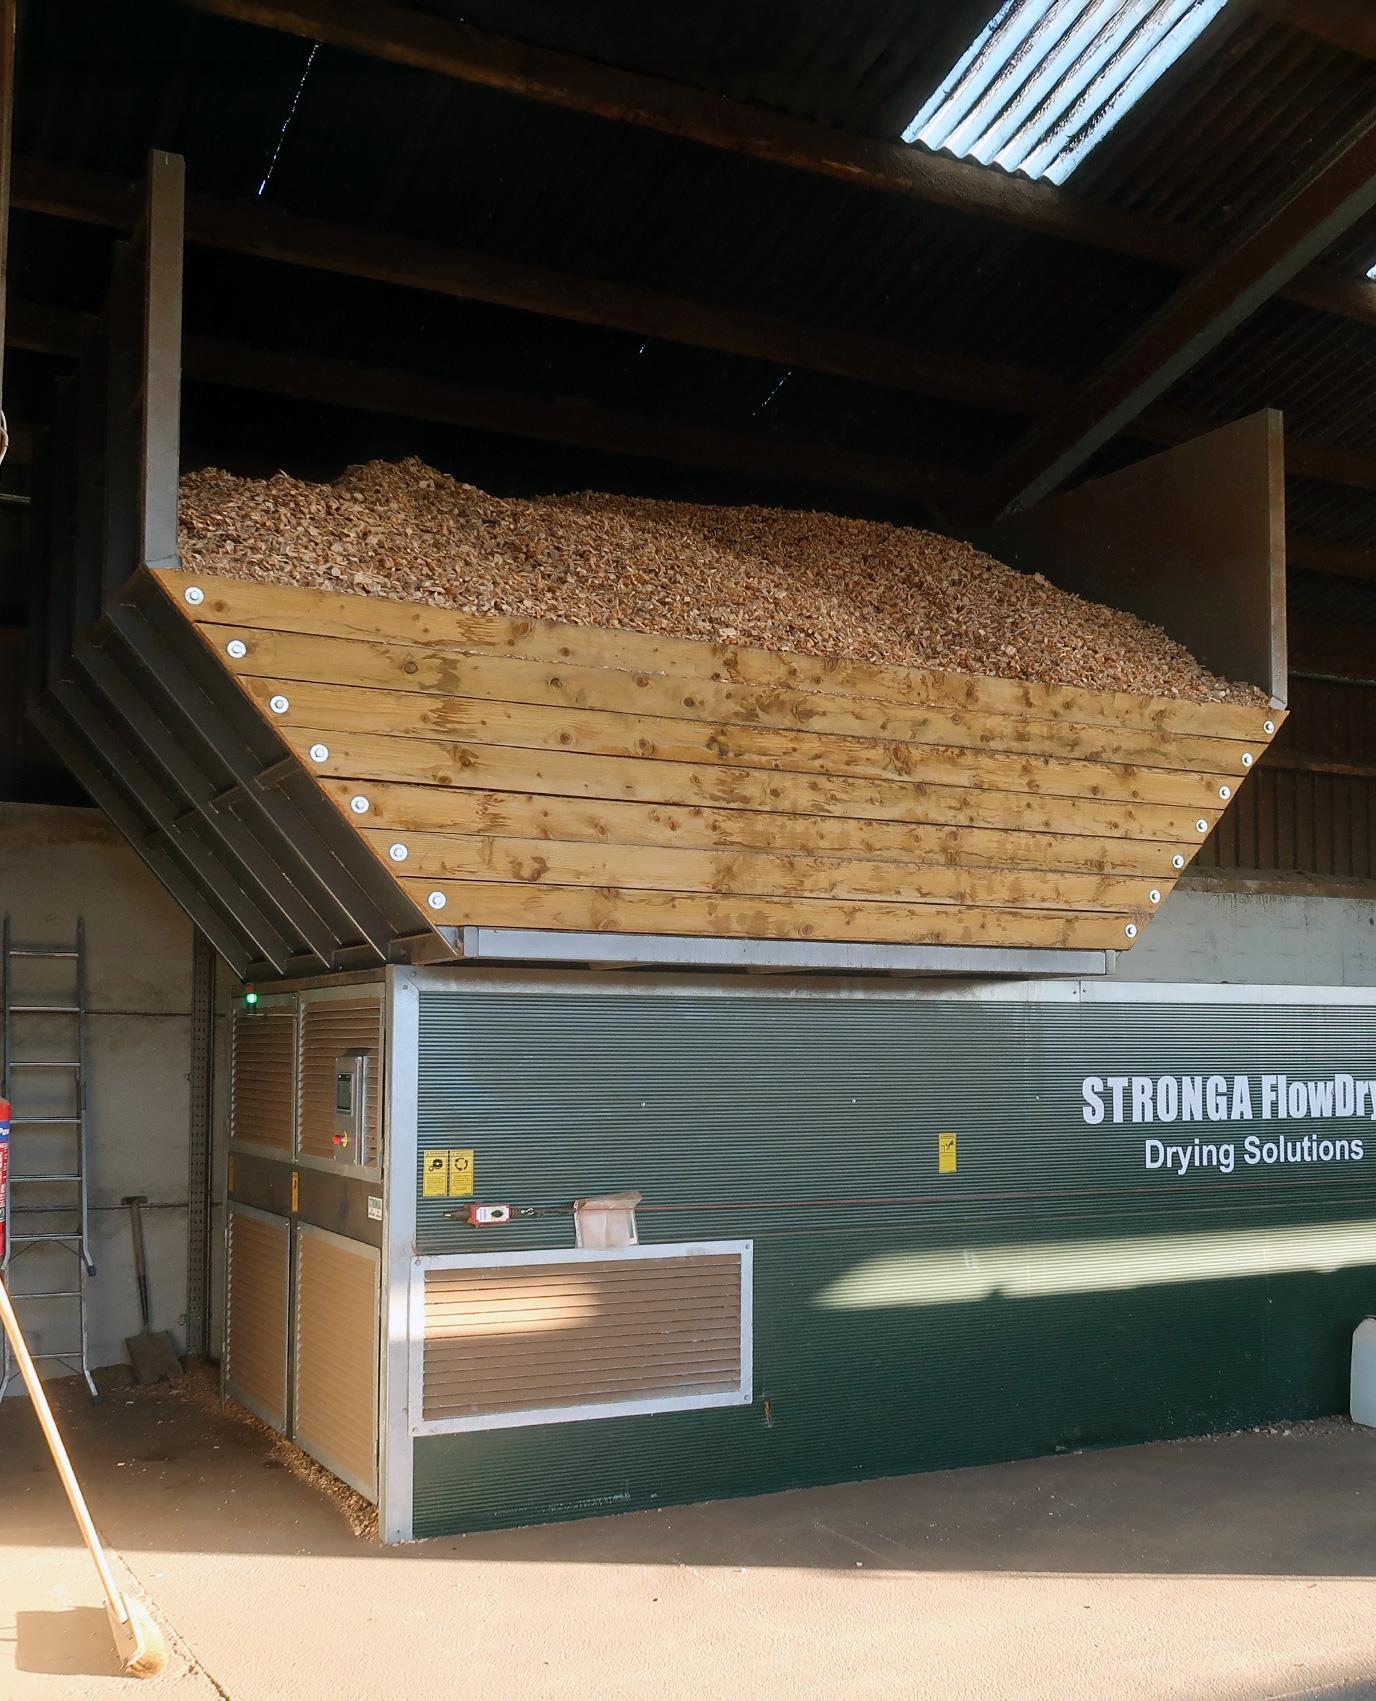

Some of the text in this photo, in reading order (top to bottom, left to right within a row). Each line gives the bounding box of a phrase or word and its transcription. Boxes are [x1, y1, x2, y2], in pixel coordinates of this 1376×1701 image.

[1081, 1074, 1254, 1125] STRONGA
[1144, 1134, 1365, 1175] Drying Solutions
